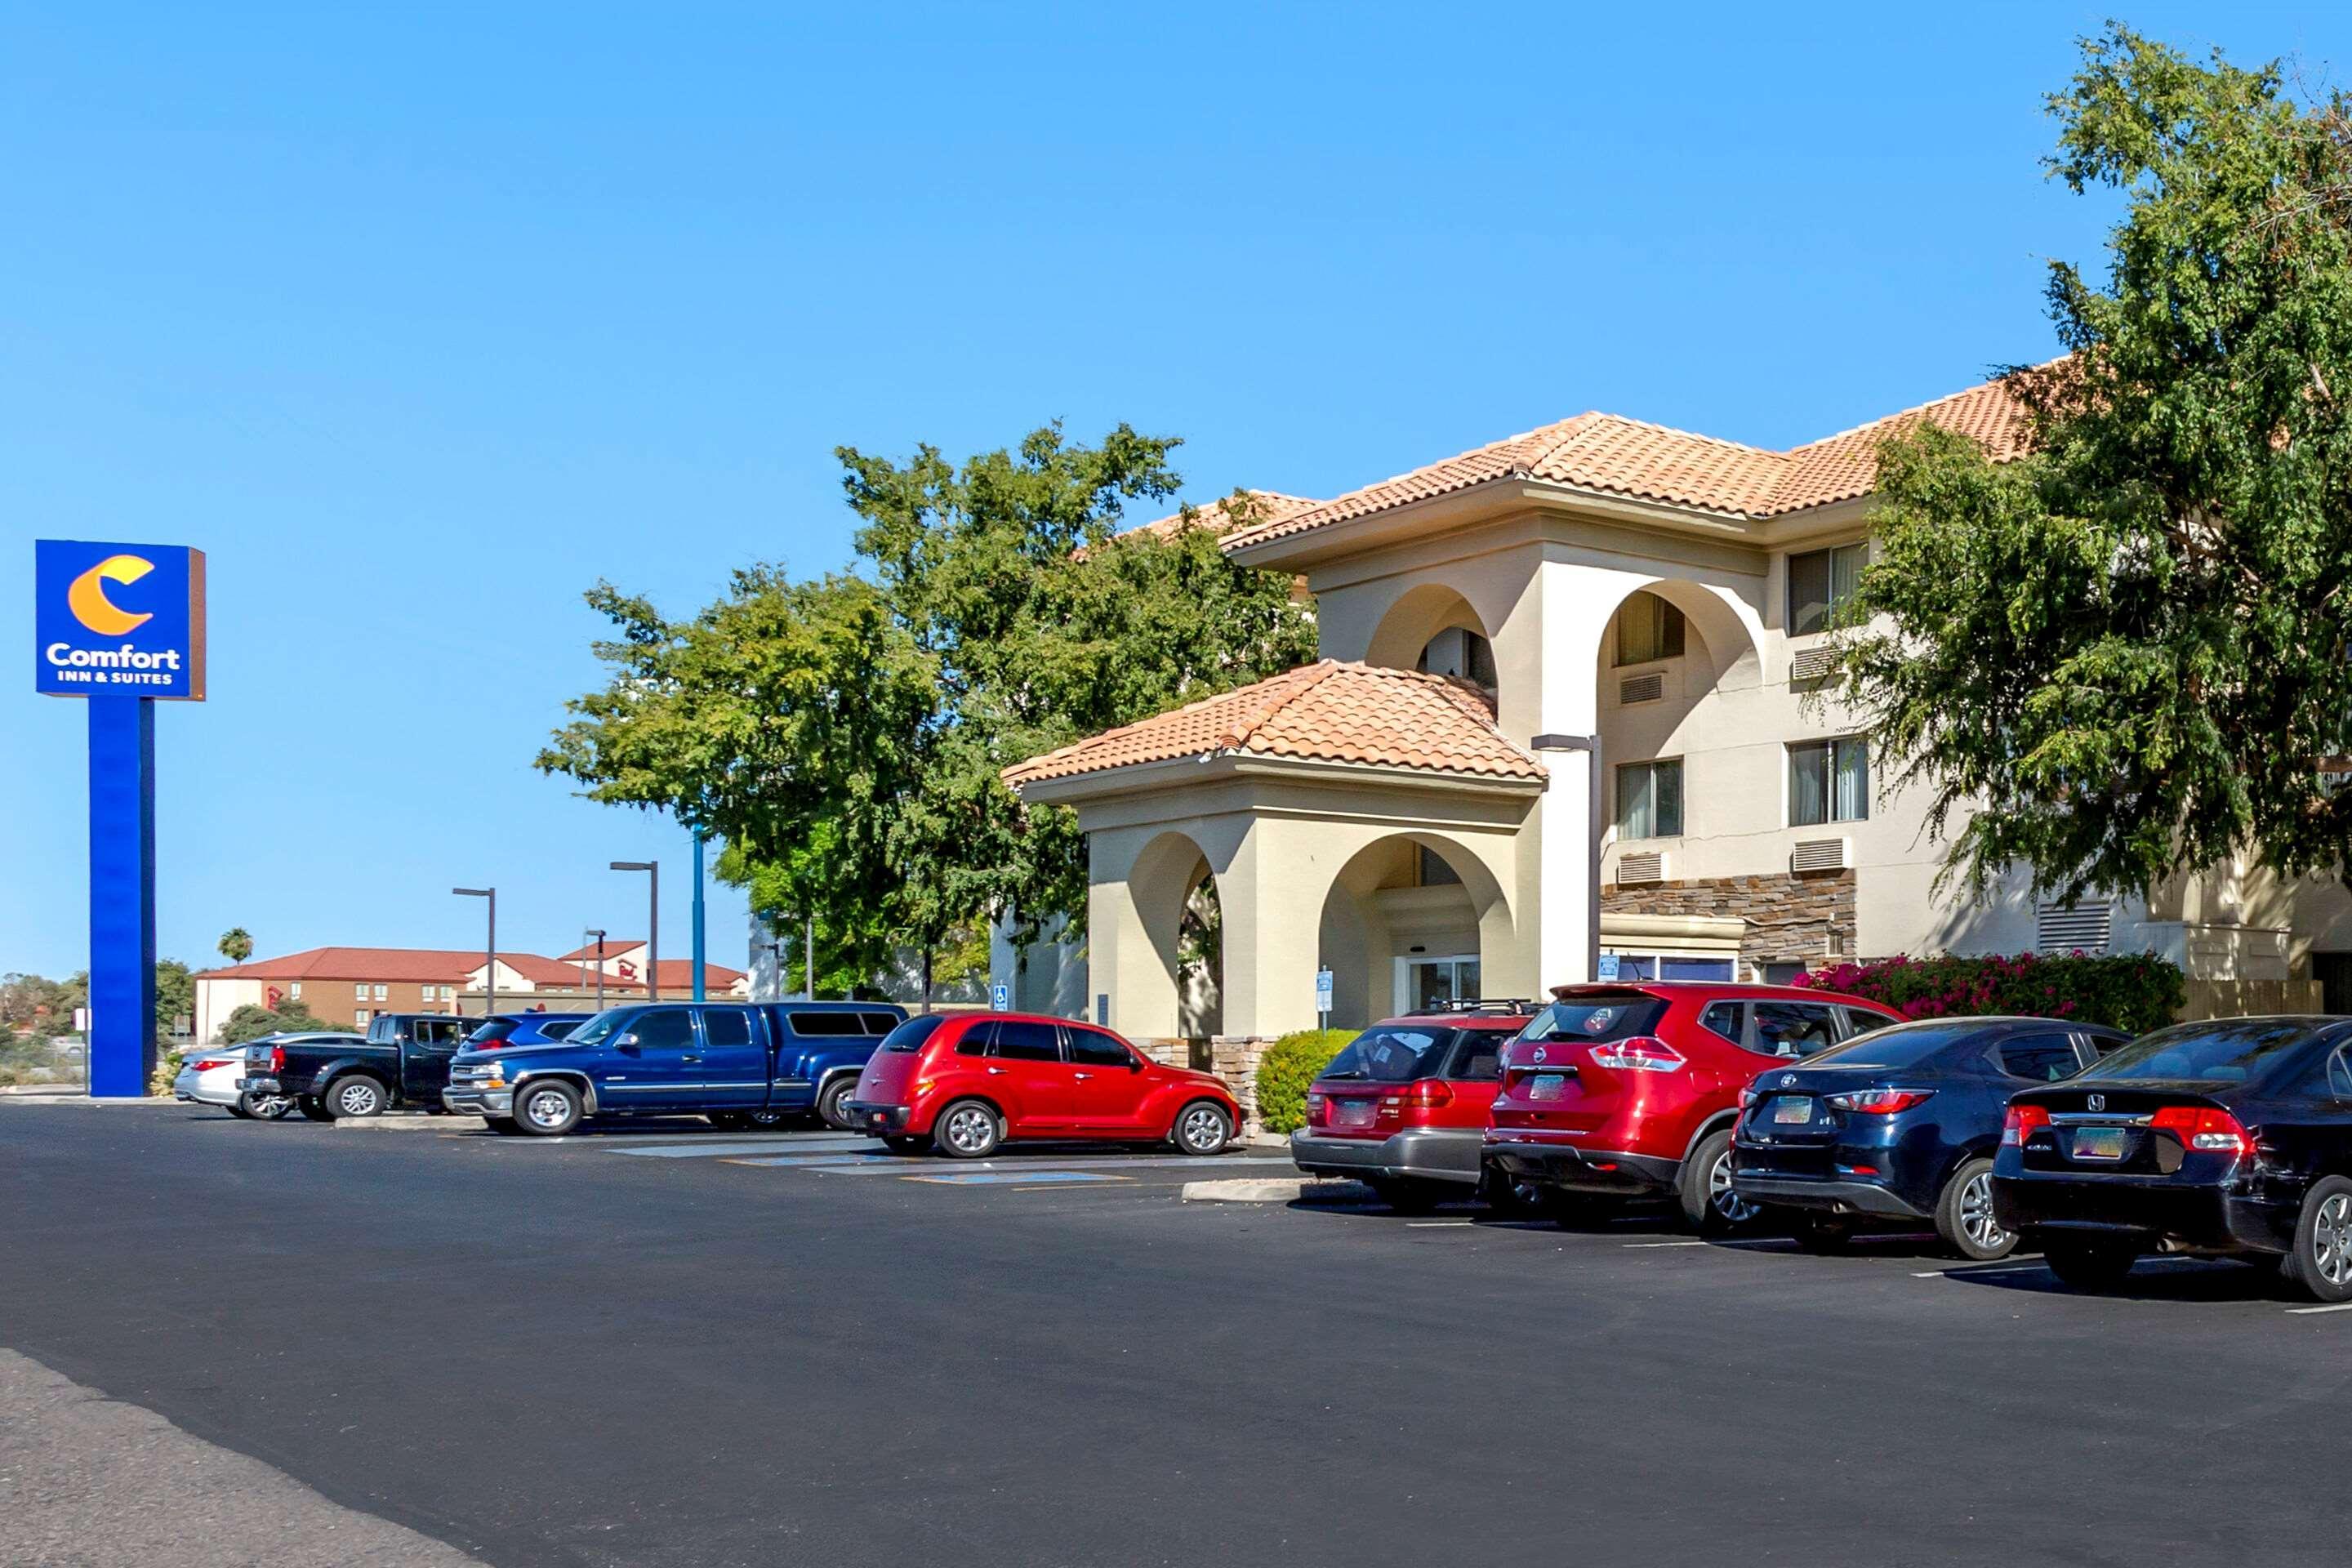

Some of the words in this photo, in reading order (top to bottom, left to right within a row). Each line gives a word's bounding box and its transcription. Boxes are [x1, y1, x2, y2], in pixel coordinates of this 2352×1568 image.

[46, 642, 180, 670] Comfort
[57, 670, 91, 682] INN
[95, 671, 108, 683] &
[111, 672, 172, 685] SUITES
